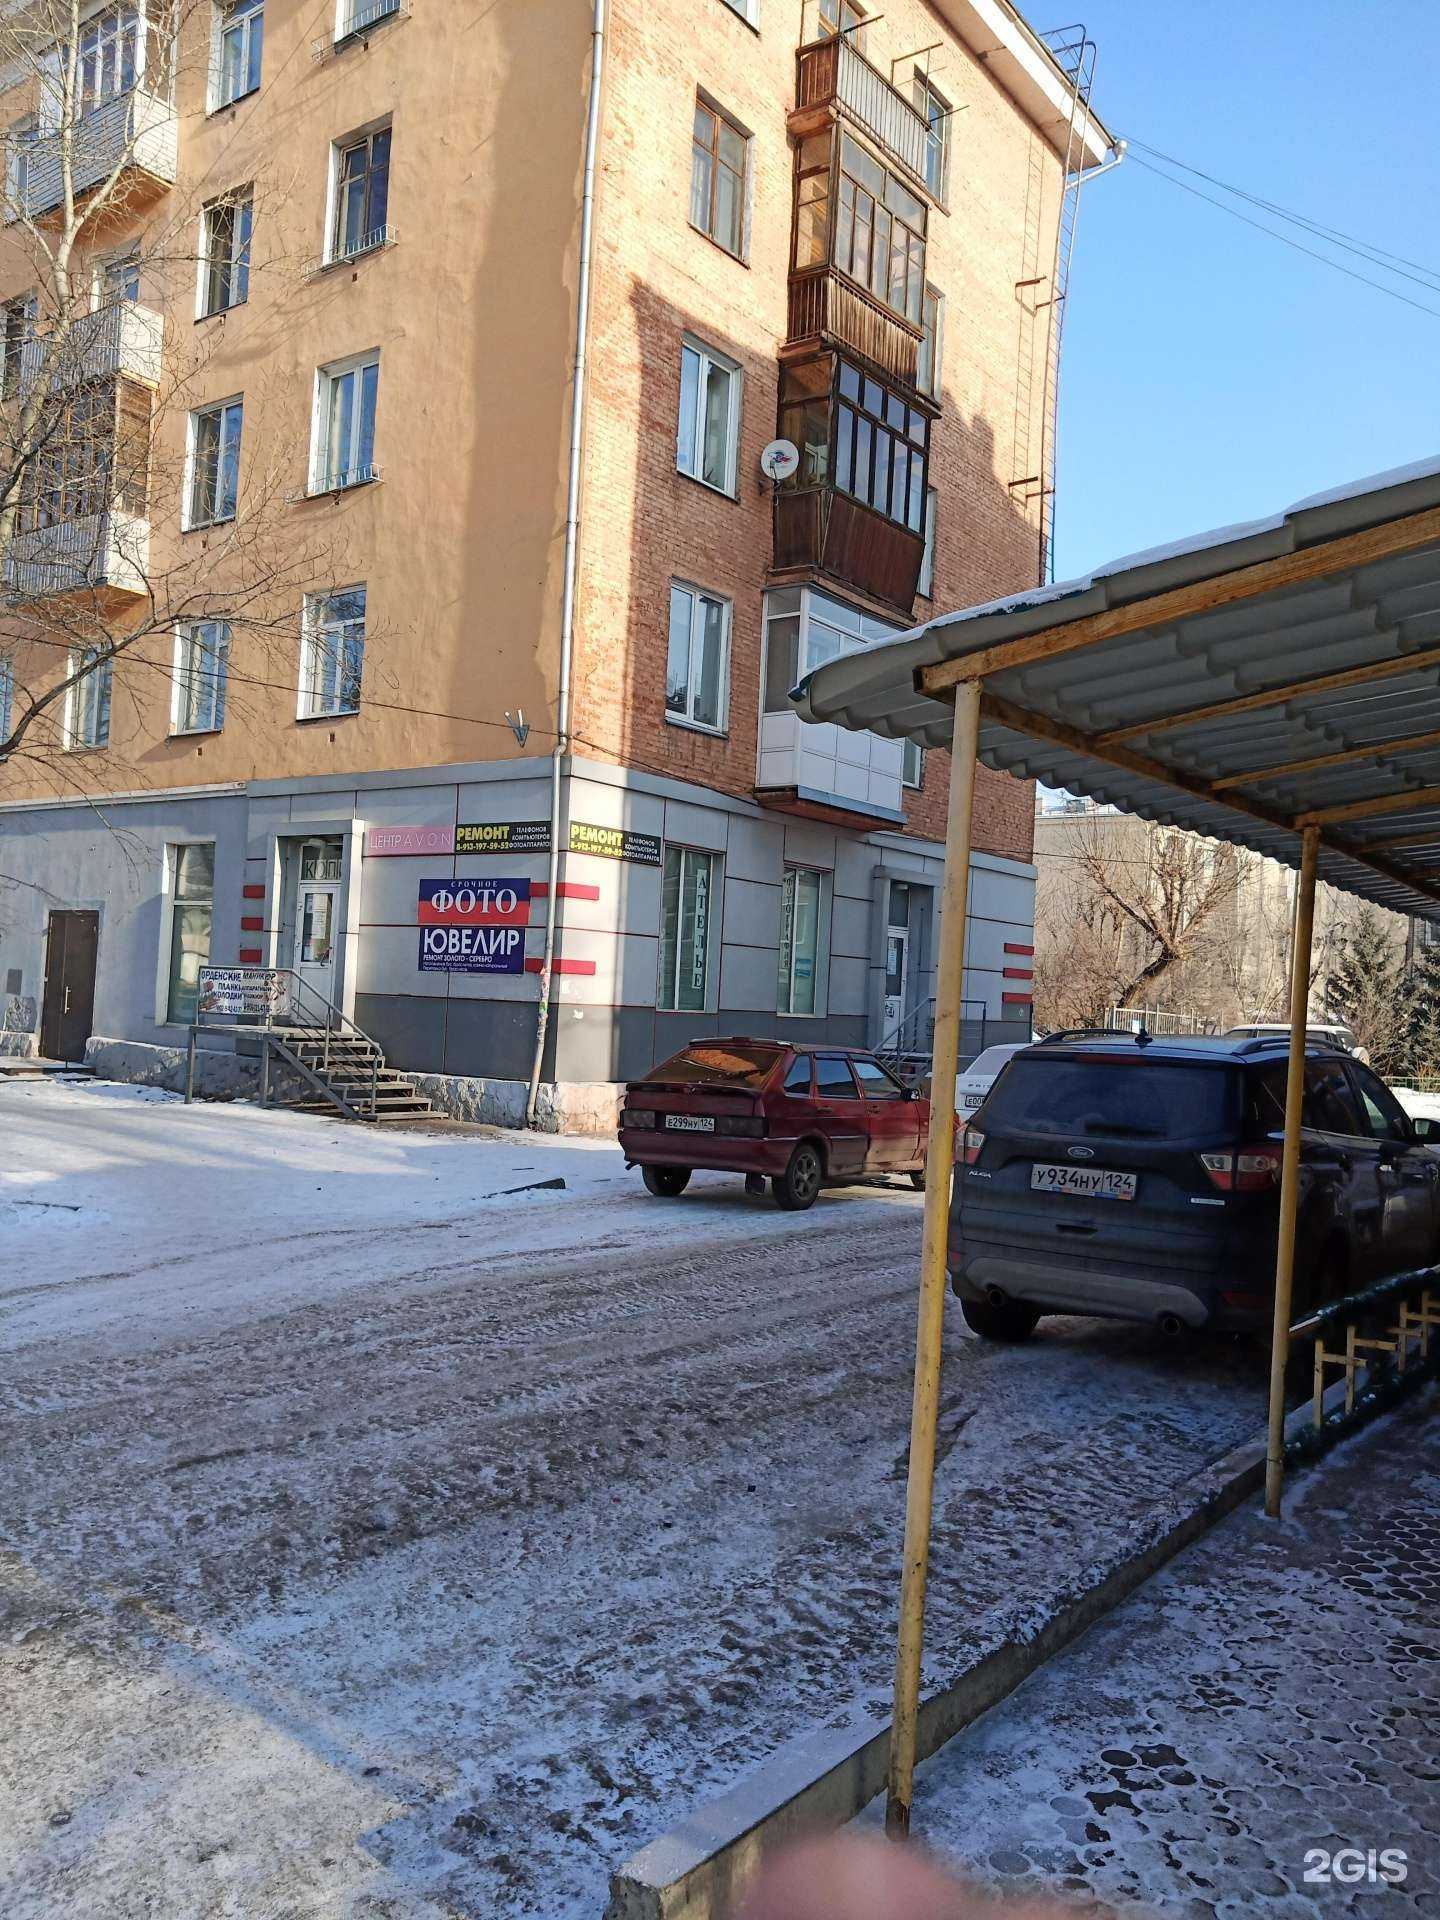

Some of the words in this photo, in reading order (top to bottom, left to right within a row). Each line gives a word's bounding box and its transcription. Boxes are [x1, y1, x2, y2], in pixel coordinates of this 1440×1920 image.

[370, 832, 402, 848] ЦЕНТР
[404, 832, 451, 848] AVON
[457, 826, 510, 841] РЕМОНТ
[571, 825, 623, 846] РЕМОНТ
[628, 837, 655, 846] ТЕЛЕФОНОВ
[456, 842, 509, 851] 8-913-197-59-52
[570, 841, 622, 857] 8-913-197-59-52
[450, 880, 498, 888] СРОЧНОЕ
[431, 888, 518, 914] ФОТО
[693, 875, 707, 988] АТЕЛЬЕ
[423, 928, 520, 955] ЮВЕЛИР
[469, 955, 493, 963] СЕРЕБРО
[201, 970, 241, 982] ОРДЕНСКИЕ
[1037, 1168, 1101, 1190] У934НУ
[1105, 1172, 1132, 1189] 124
